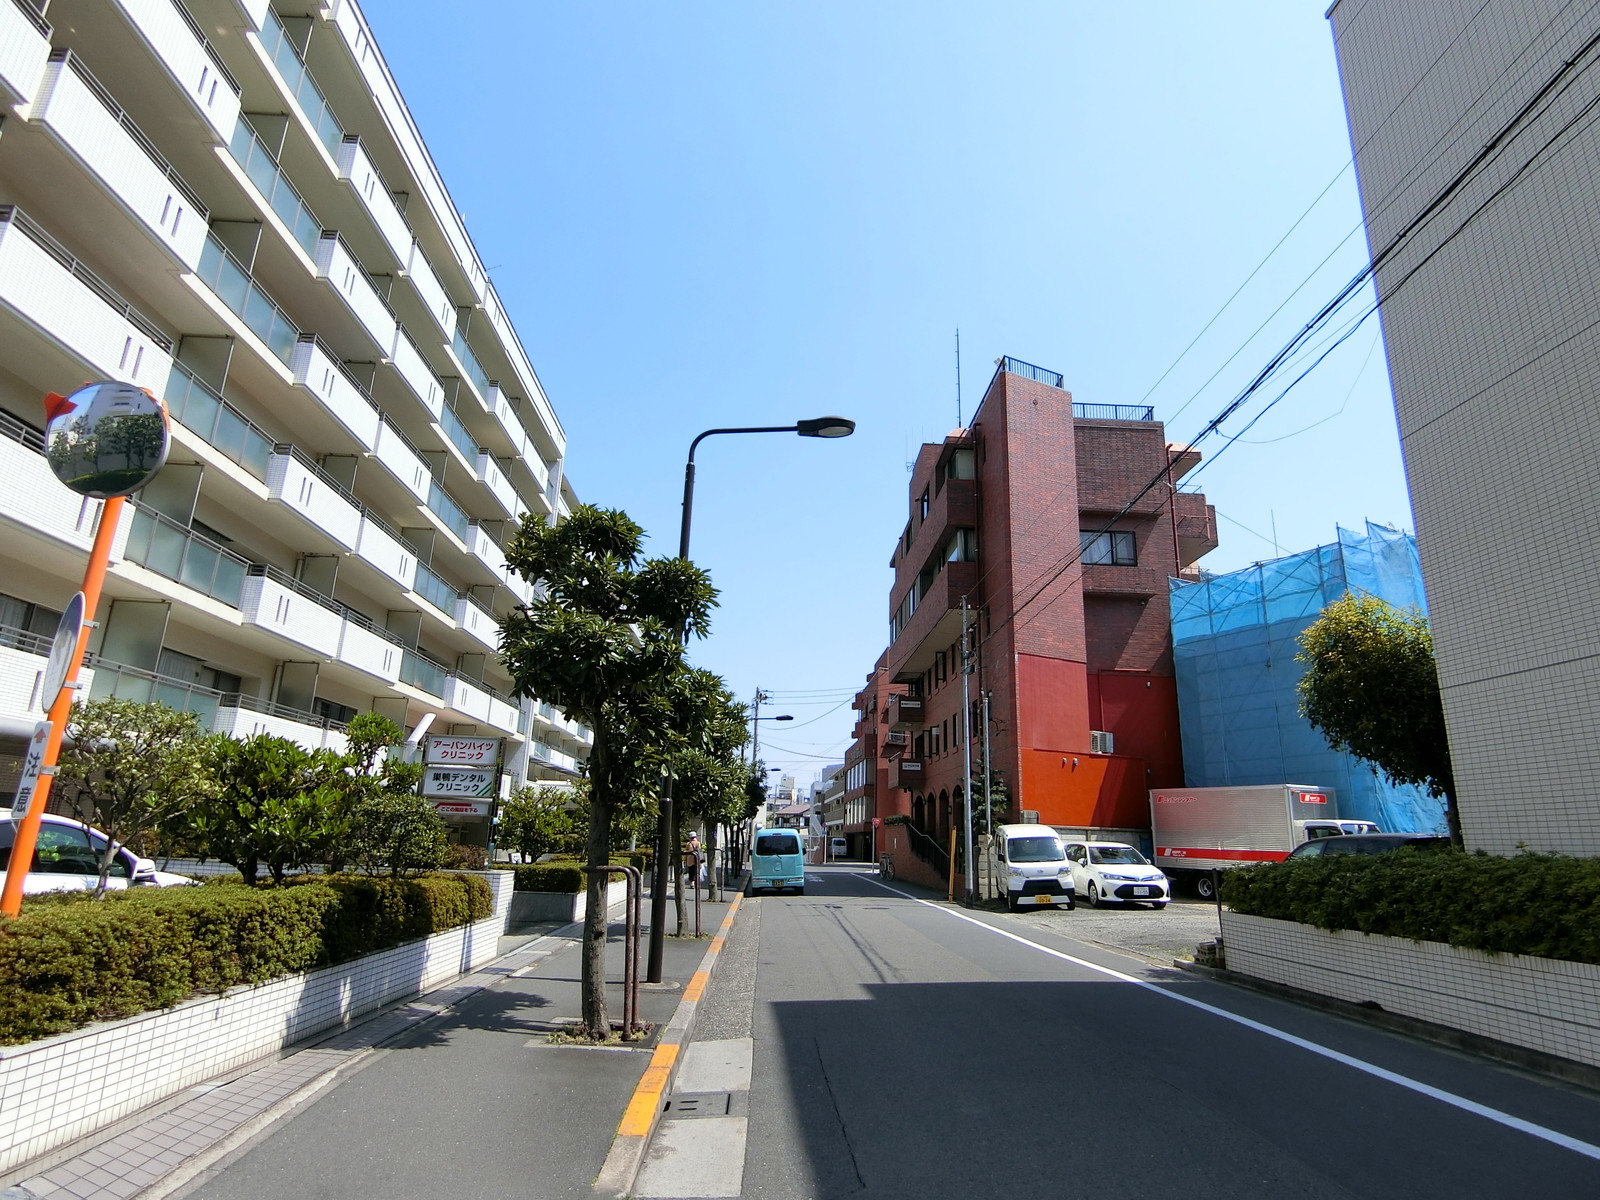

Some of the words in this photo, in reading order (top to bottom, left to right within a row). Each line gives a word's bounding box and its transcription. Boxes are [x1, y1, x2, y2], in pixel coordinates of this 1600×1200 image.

[433, 740, 494, 751] アーバンハイツ
[441, 750, 484, 760] クリニック
[13, 751, 41, 813] 注意
[432, 772, 486, 783] 巣鴨デンタル
[436, 782, 480, 792] クリニック
